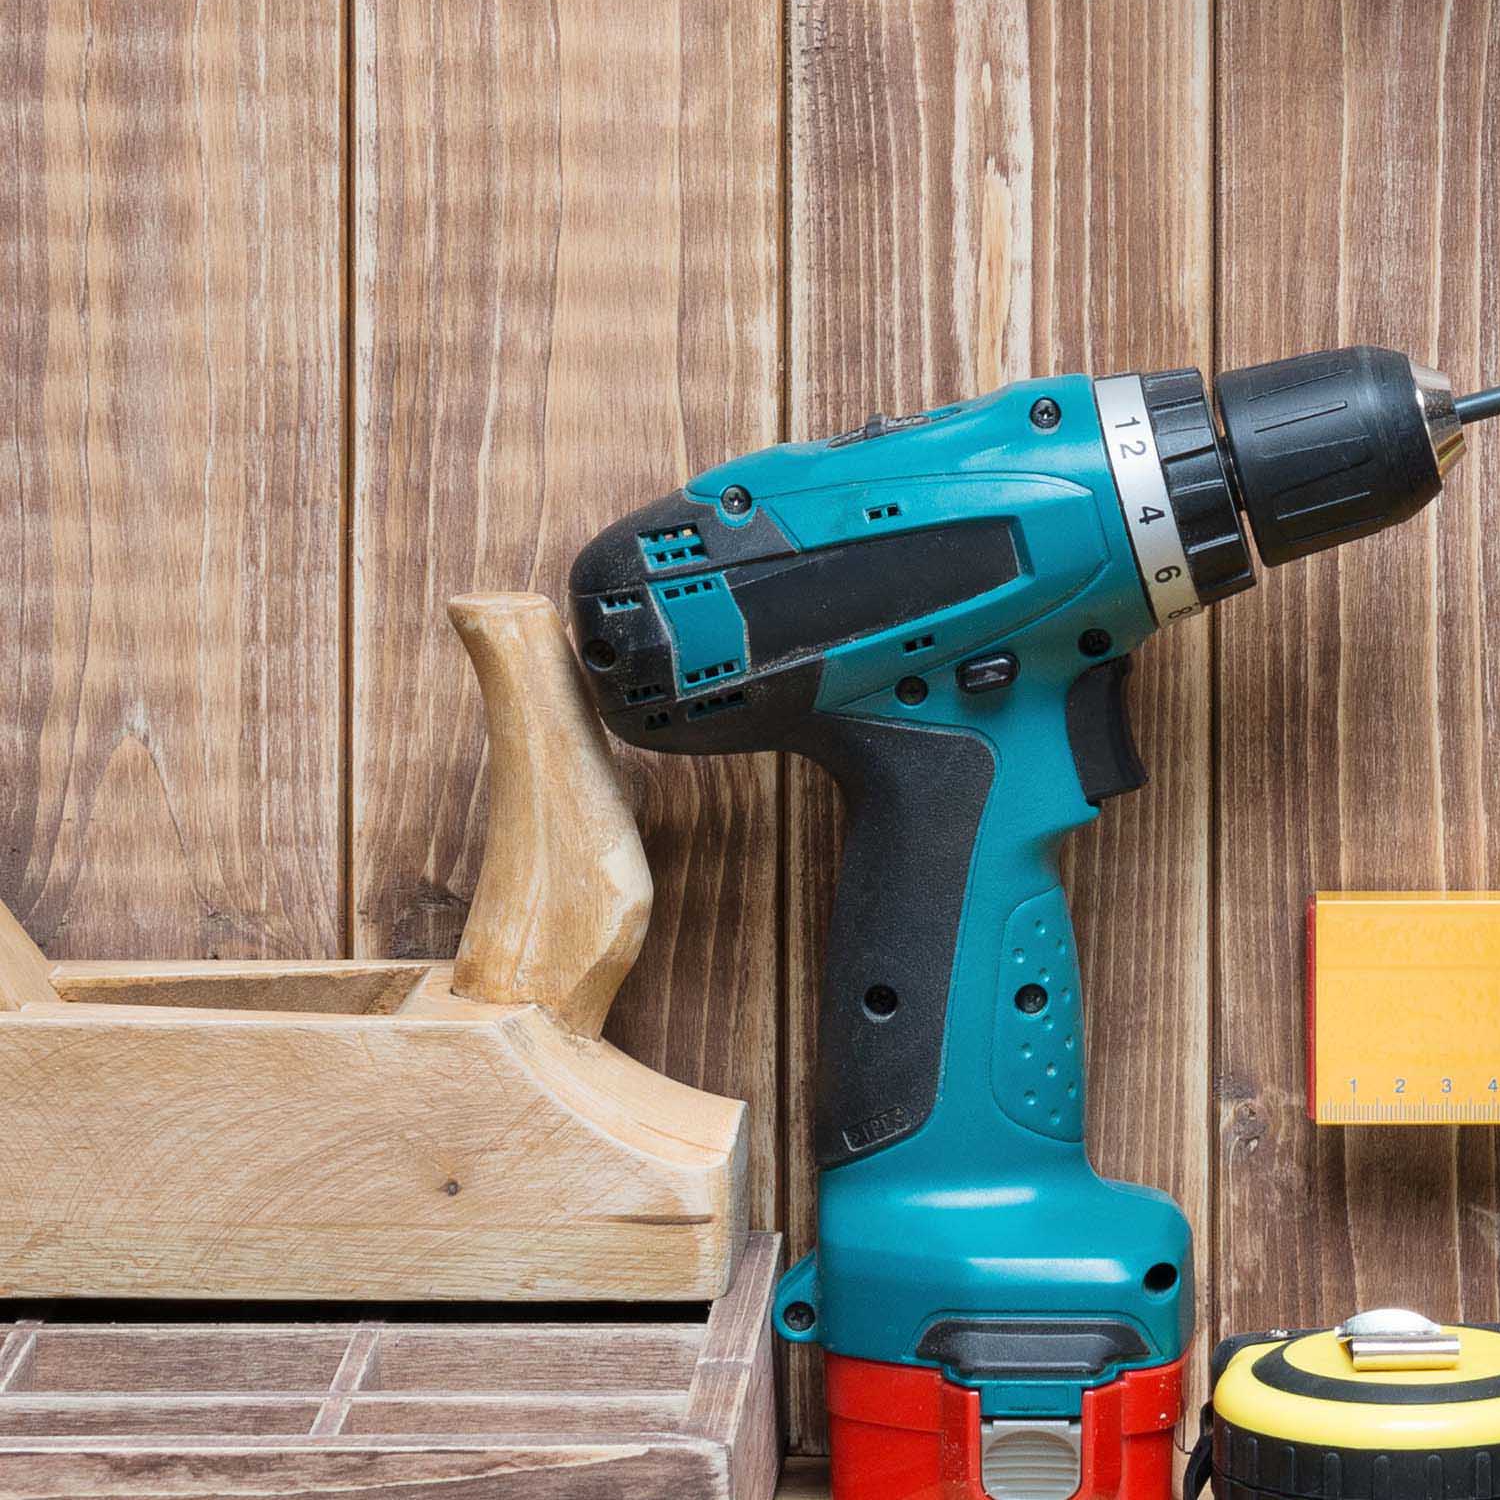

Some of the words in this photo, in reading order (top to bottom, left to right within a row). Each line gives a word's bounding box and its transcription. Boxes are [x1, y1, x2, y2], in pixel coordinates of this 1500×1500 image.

[1139, 506, 1165, 524] 4
[1155, 565, 1182, 583] 6
[1350, 1077, 1357, 1094] 1
[1395, 1077, 1406, 1094] 2
[1441, 1077, 1452, 1094] 3
[1487, 1077, 1499, 1094] 4
